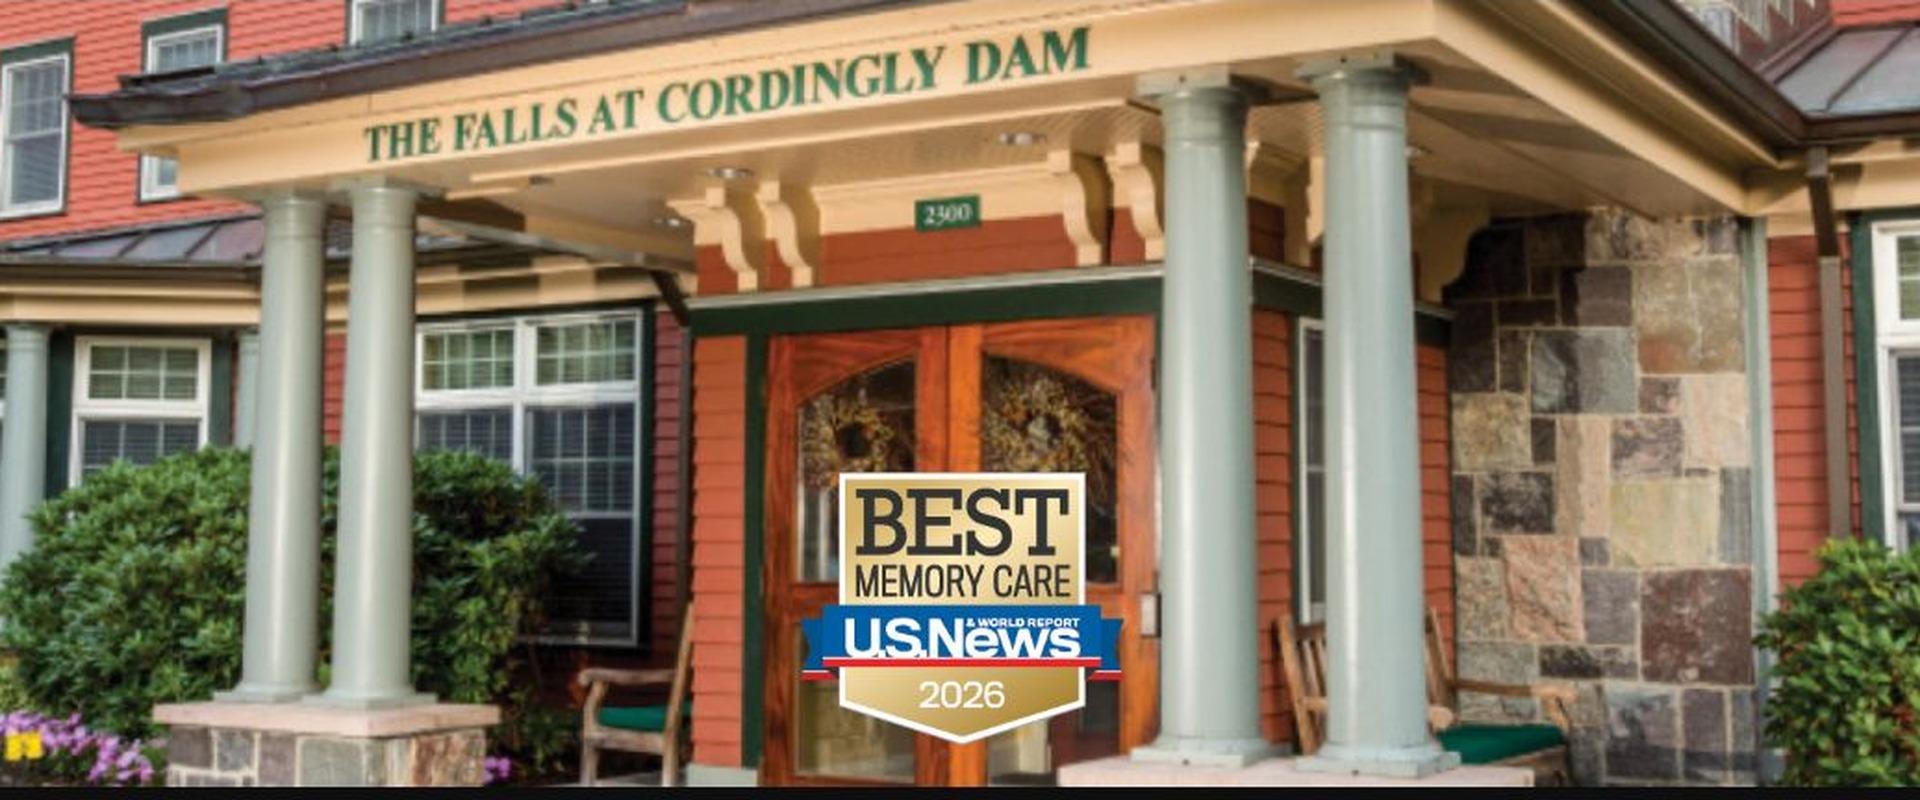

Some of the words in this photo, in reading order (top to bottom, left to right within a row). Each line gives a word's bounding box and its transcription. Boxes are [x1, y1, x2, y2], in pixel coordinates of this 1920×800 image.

[364, 119, 441, 162] THE
[453, 97, 578, 152] FALLS
[588, 89, 645, 135] AT
[657, 45, 946, 124] CORDINGLY
[964, 26, 1091, 84] DAM
[923, 202, 972, 226] 2300
